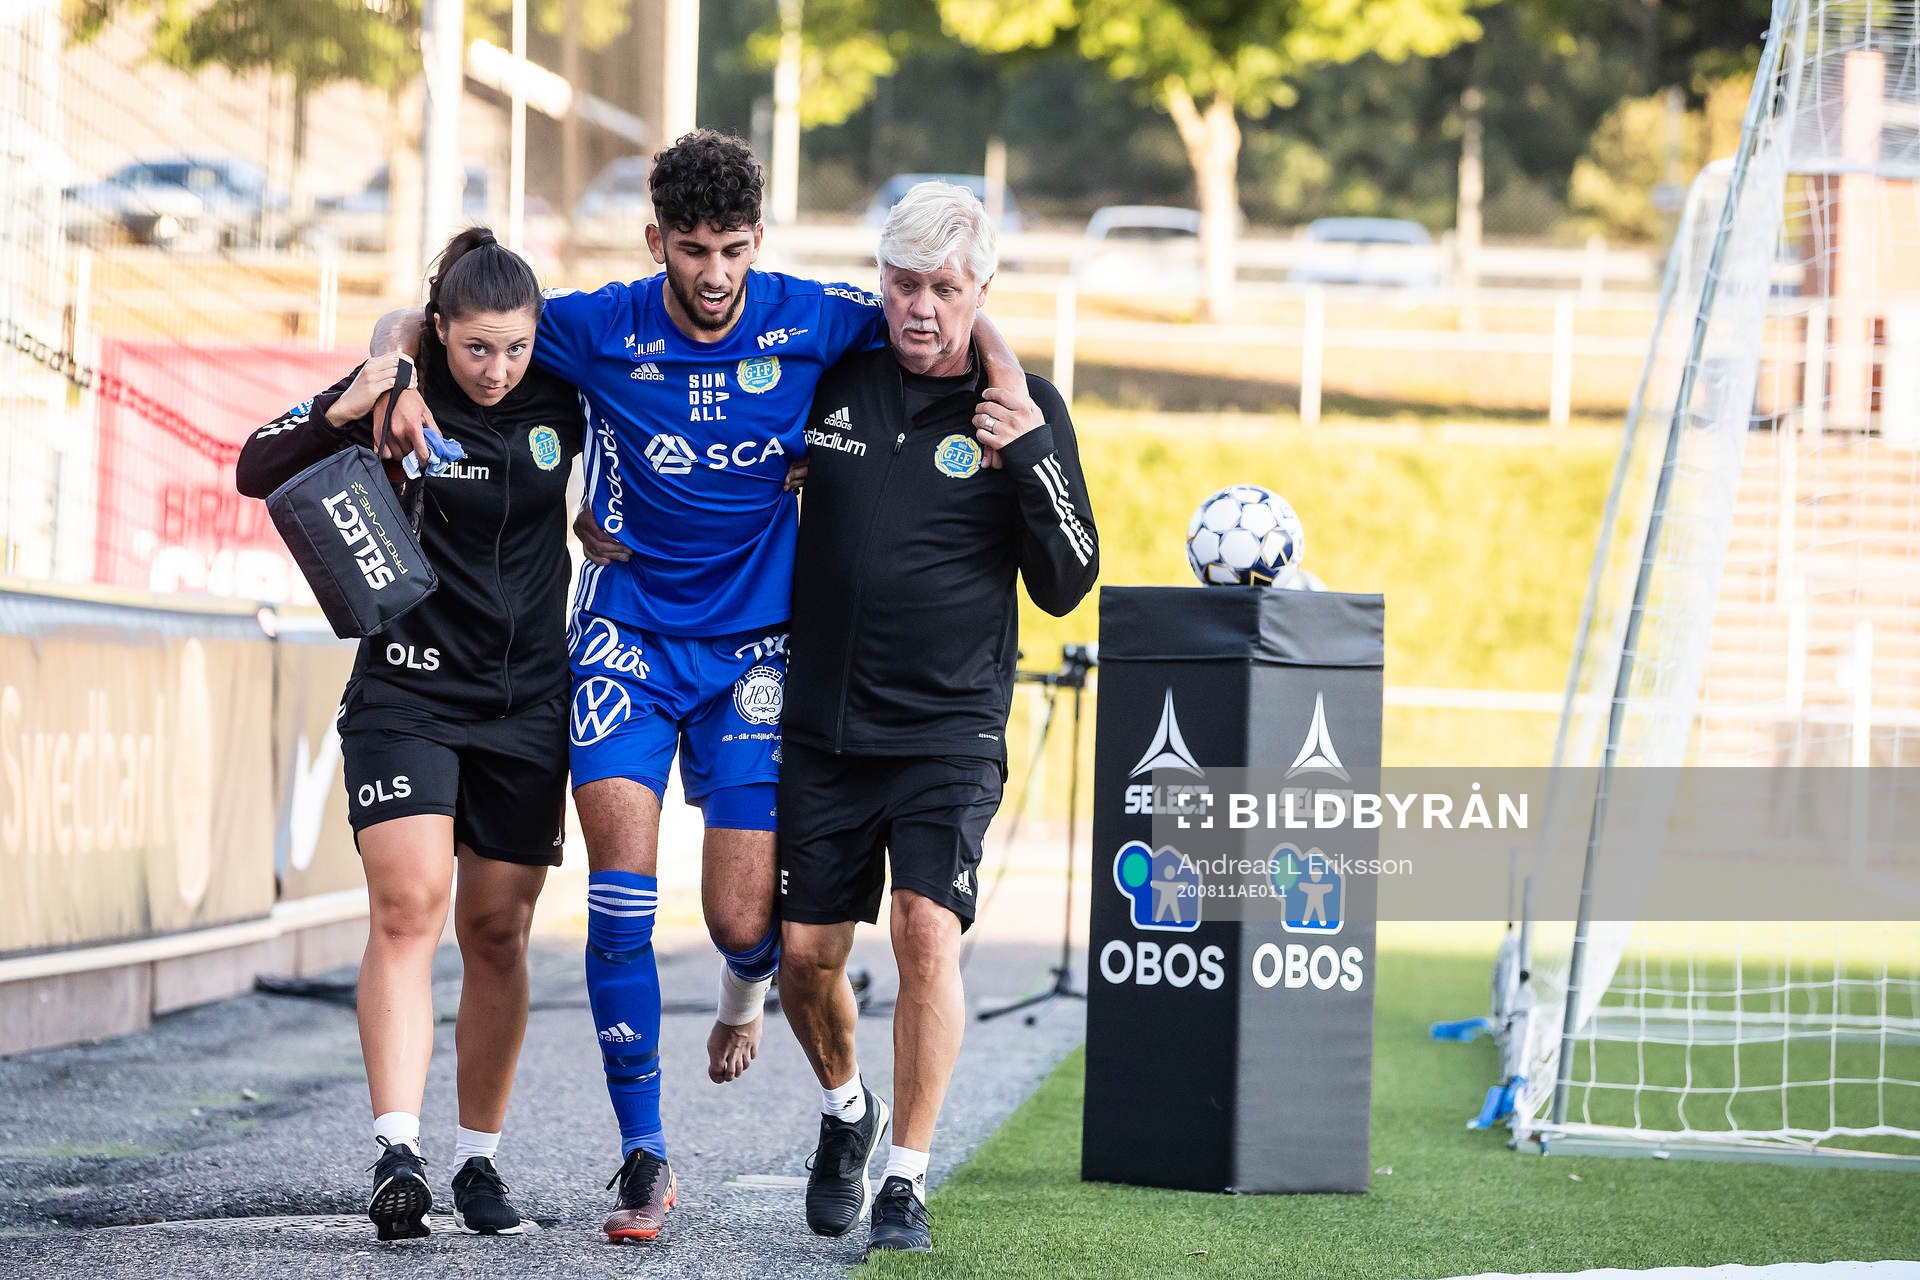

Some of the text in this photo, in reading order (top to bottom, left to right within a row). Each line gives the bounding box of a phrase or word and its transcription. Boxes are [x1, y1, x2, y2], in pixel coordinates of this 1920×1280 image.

[757, 328, 789, 349] NP3
[630, 371, 665, 381] adidas
[689, 372, 726, 389] SUN
[690, 406, 727, 421] ALL
[824, 417, 853, 431] adidas
[706, 437, 785, 470] SCA
[807, 427, 867, 457] stadium
[440, 461, 490, 480] dium
[321, 490, 396, 591] SELECT
[359, 496, 408, 575] PROFCARE
[386, 643, 441, 671] OLS
[579, 617, 651, 680] Diös
[744, 686, 781, 706] HSB
[358, 776, 412, 807] OLS
[1100, 939, 1225, 991] OBOS
[1252, 942, 1363, 992] OBOS
